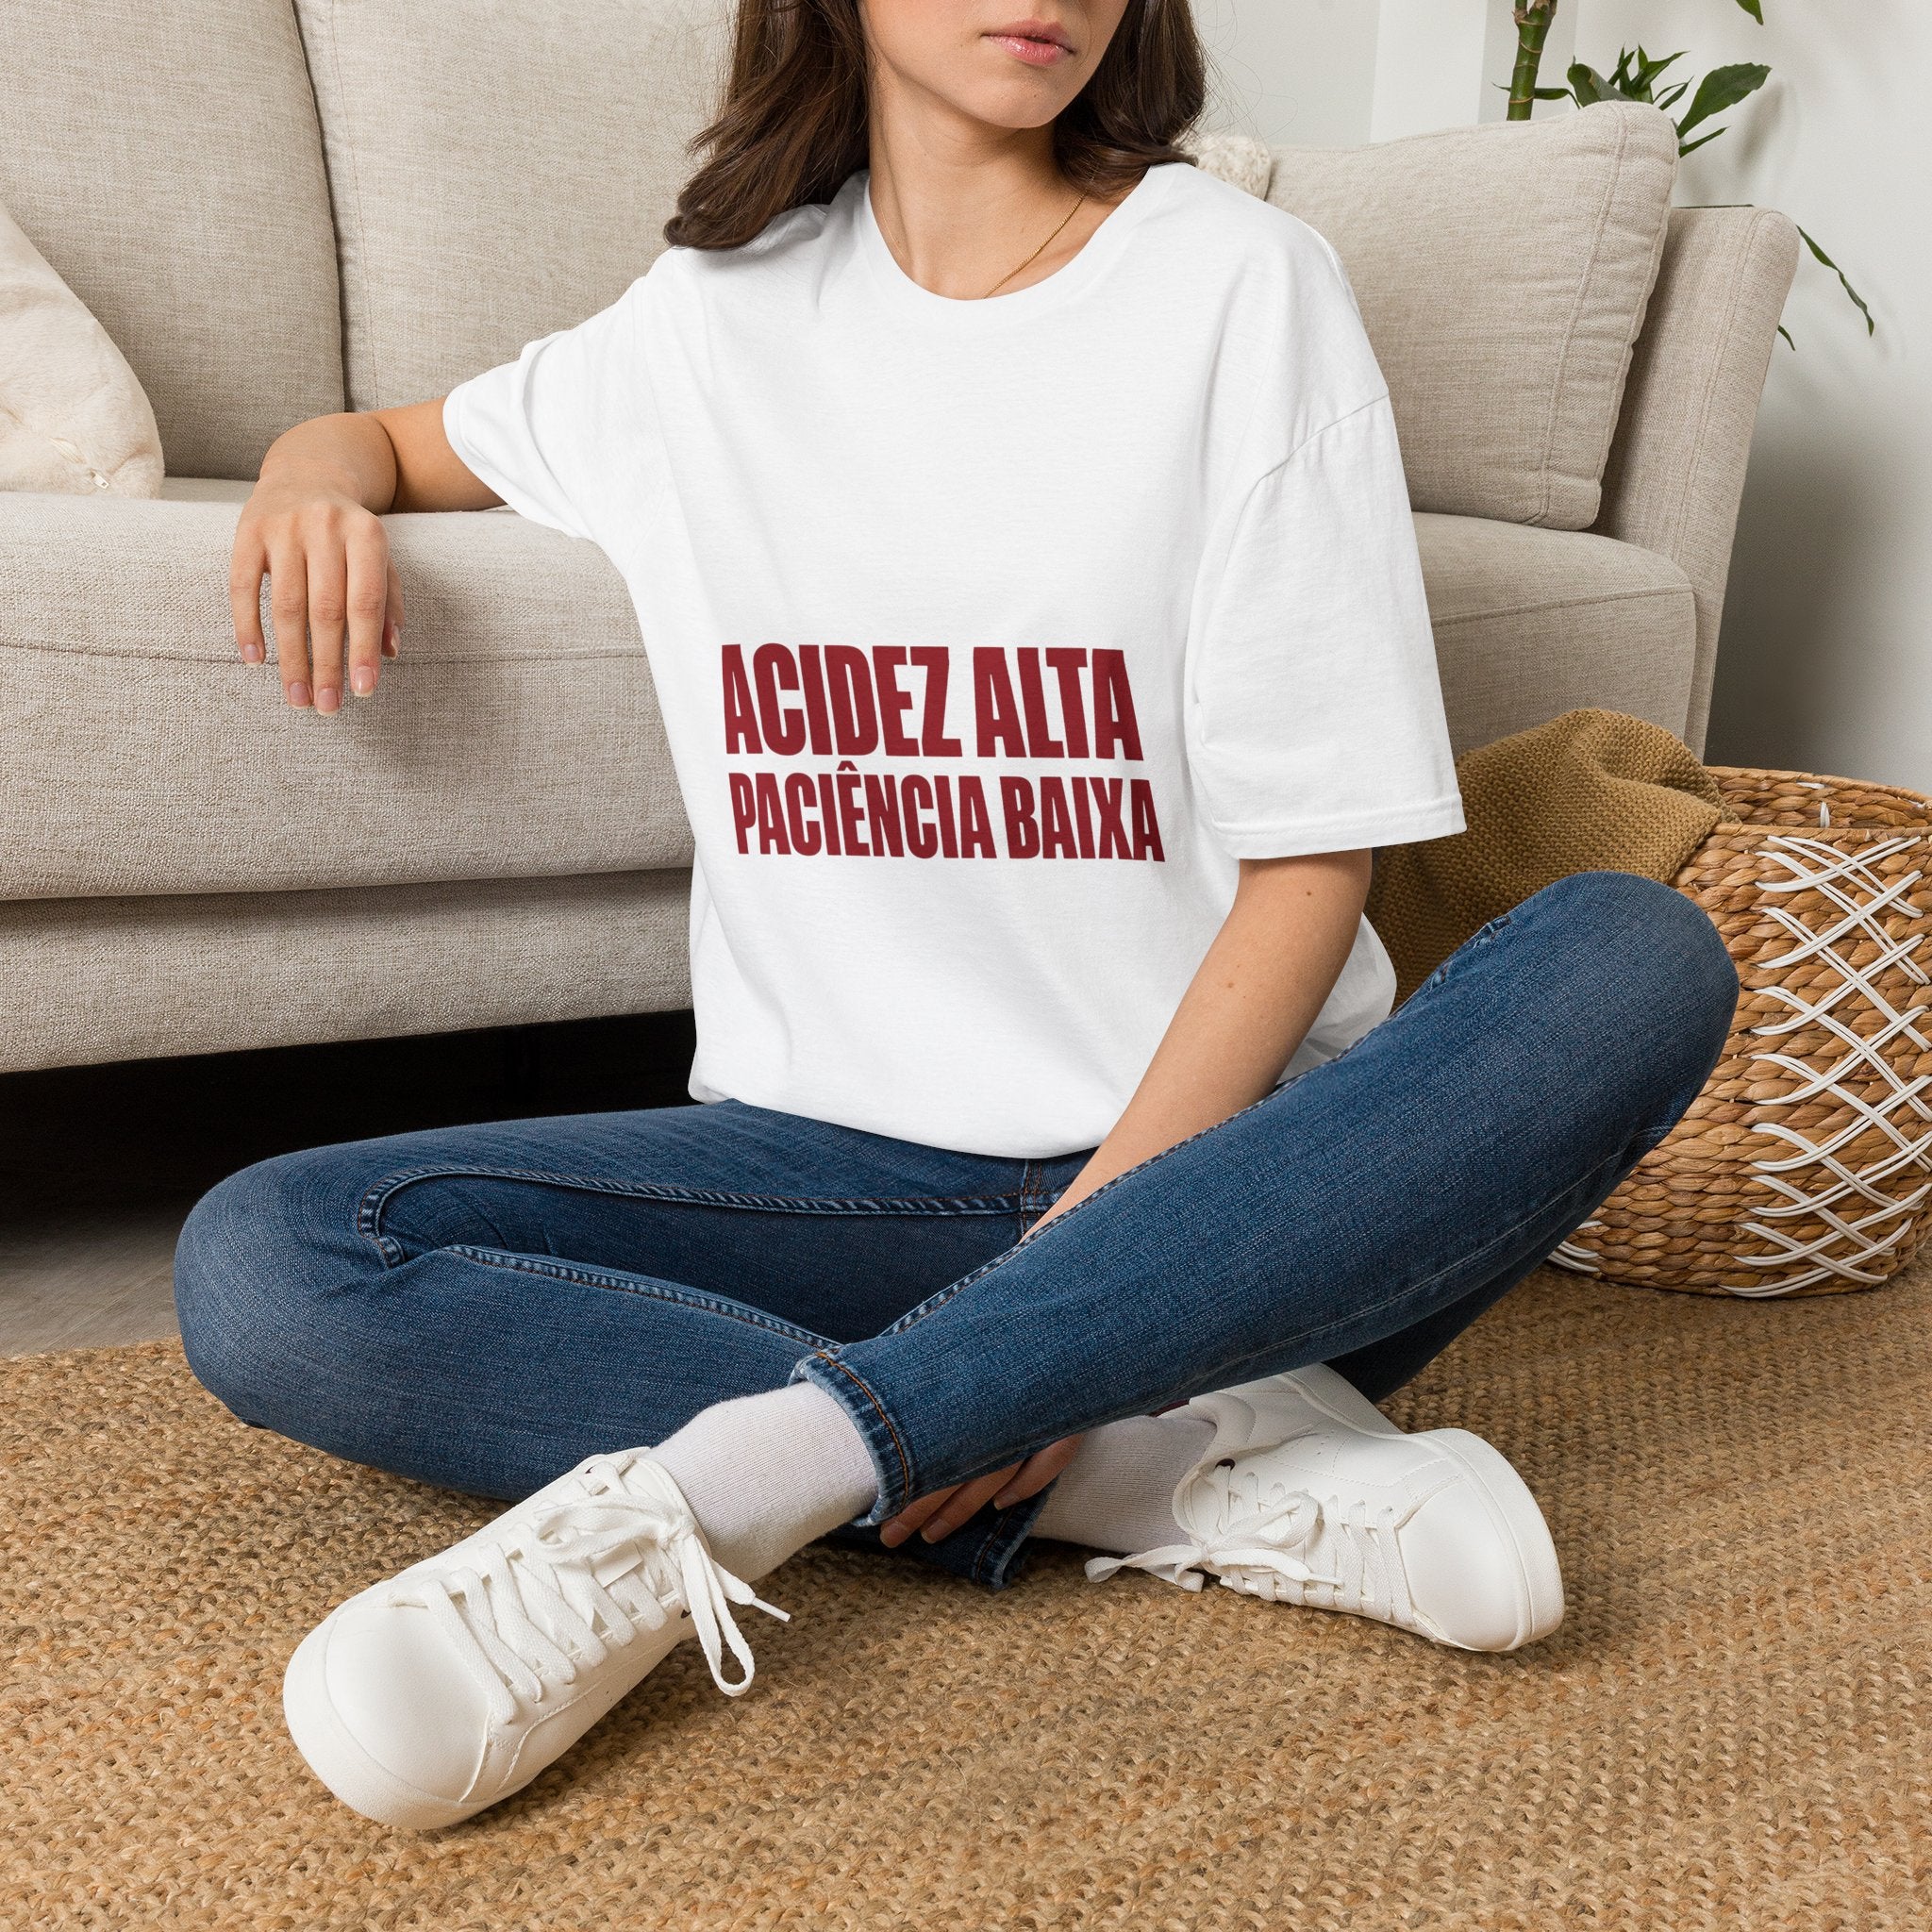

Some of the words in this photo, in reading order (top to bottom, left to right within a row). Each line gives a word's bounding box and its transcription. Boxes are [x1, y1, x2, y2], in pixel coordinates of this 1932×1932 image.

[722, 642, 963, 758] ACIDEZ
[973, 646, 1143, 761] ALTA
[728, 759, 997, 859] PACIÊNCIA
[999, 775, 1165, 862] BAIXA
